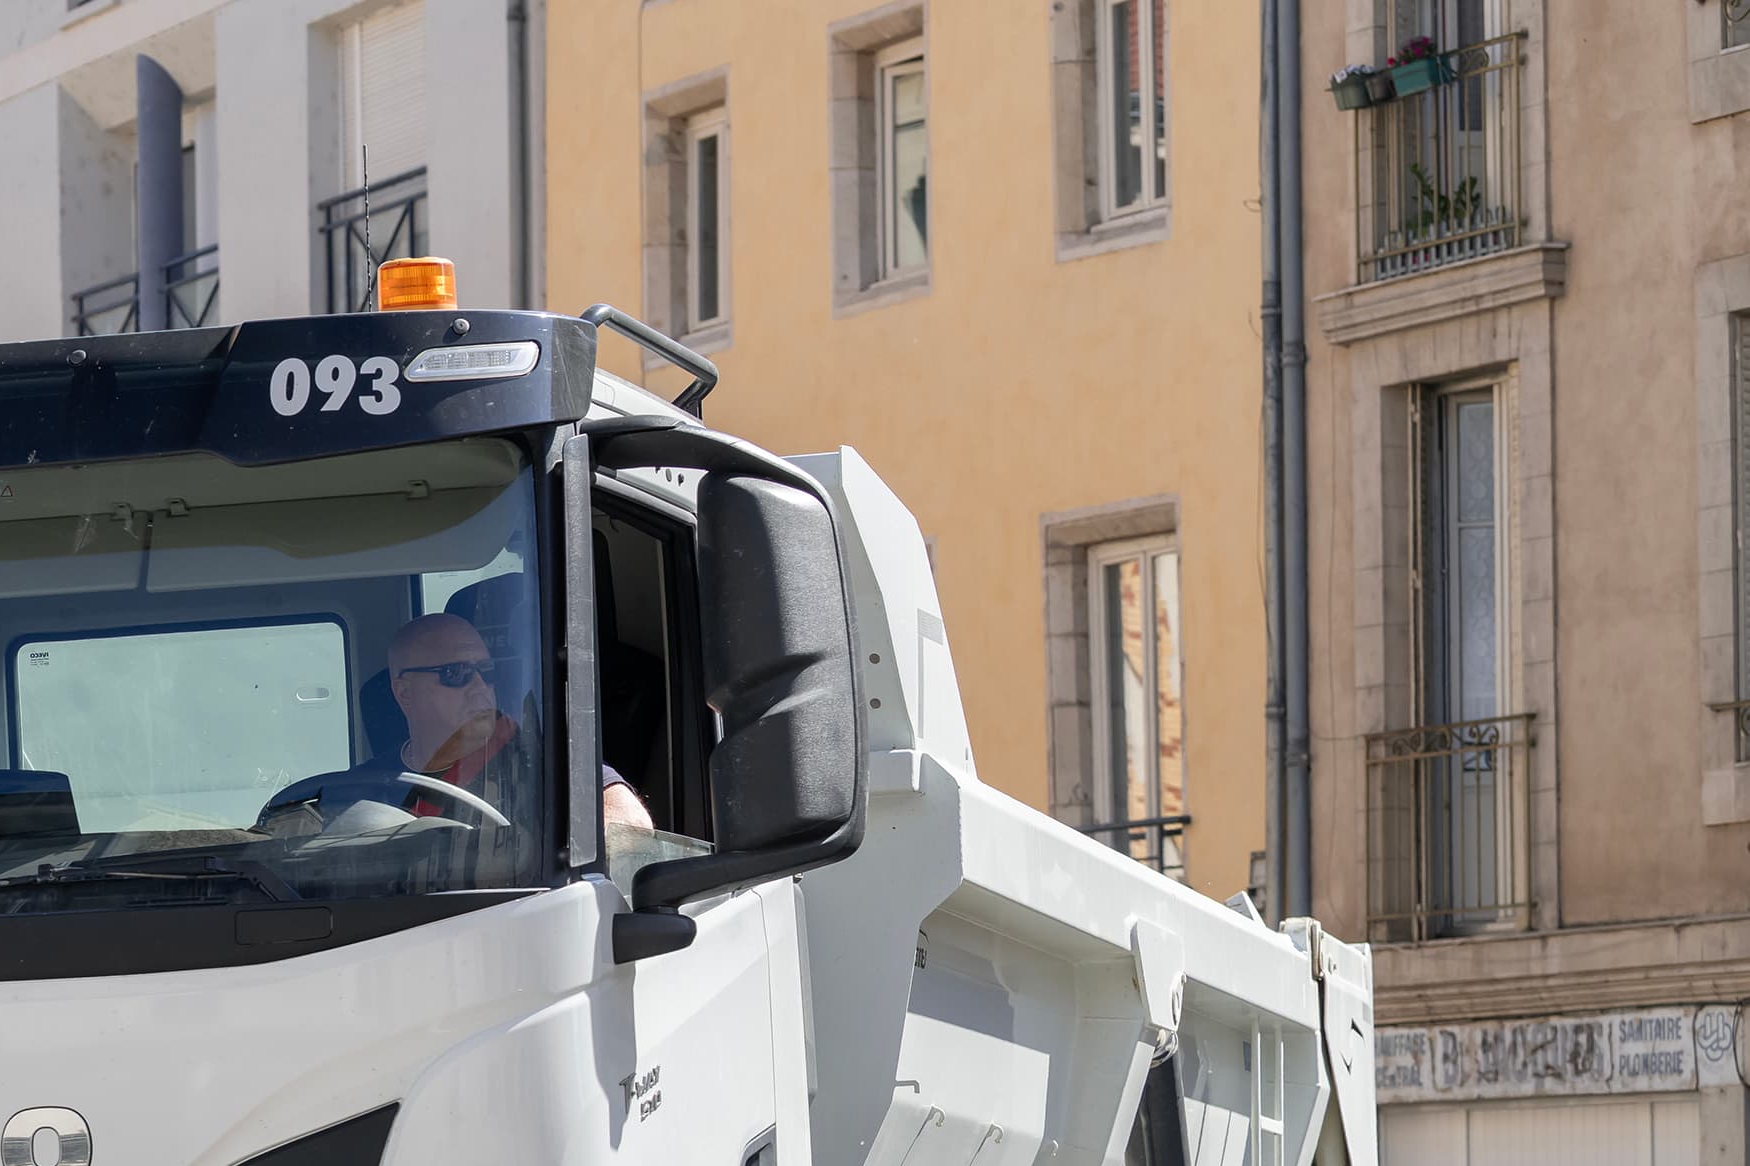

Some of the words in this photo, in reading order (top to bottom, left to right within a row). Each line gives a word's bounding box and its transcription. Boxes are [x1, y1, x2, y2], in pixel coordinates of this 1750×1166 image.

[269, 354, 402, 417] 093
[1618, 1017, 1682, 1043] SANITAIRE
[1618, 1050, 1684, 1077] PLOMBERIE
